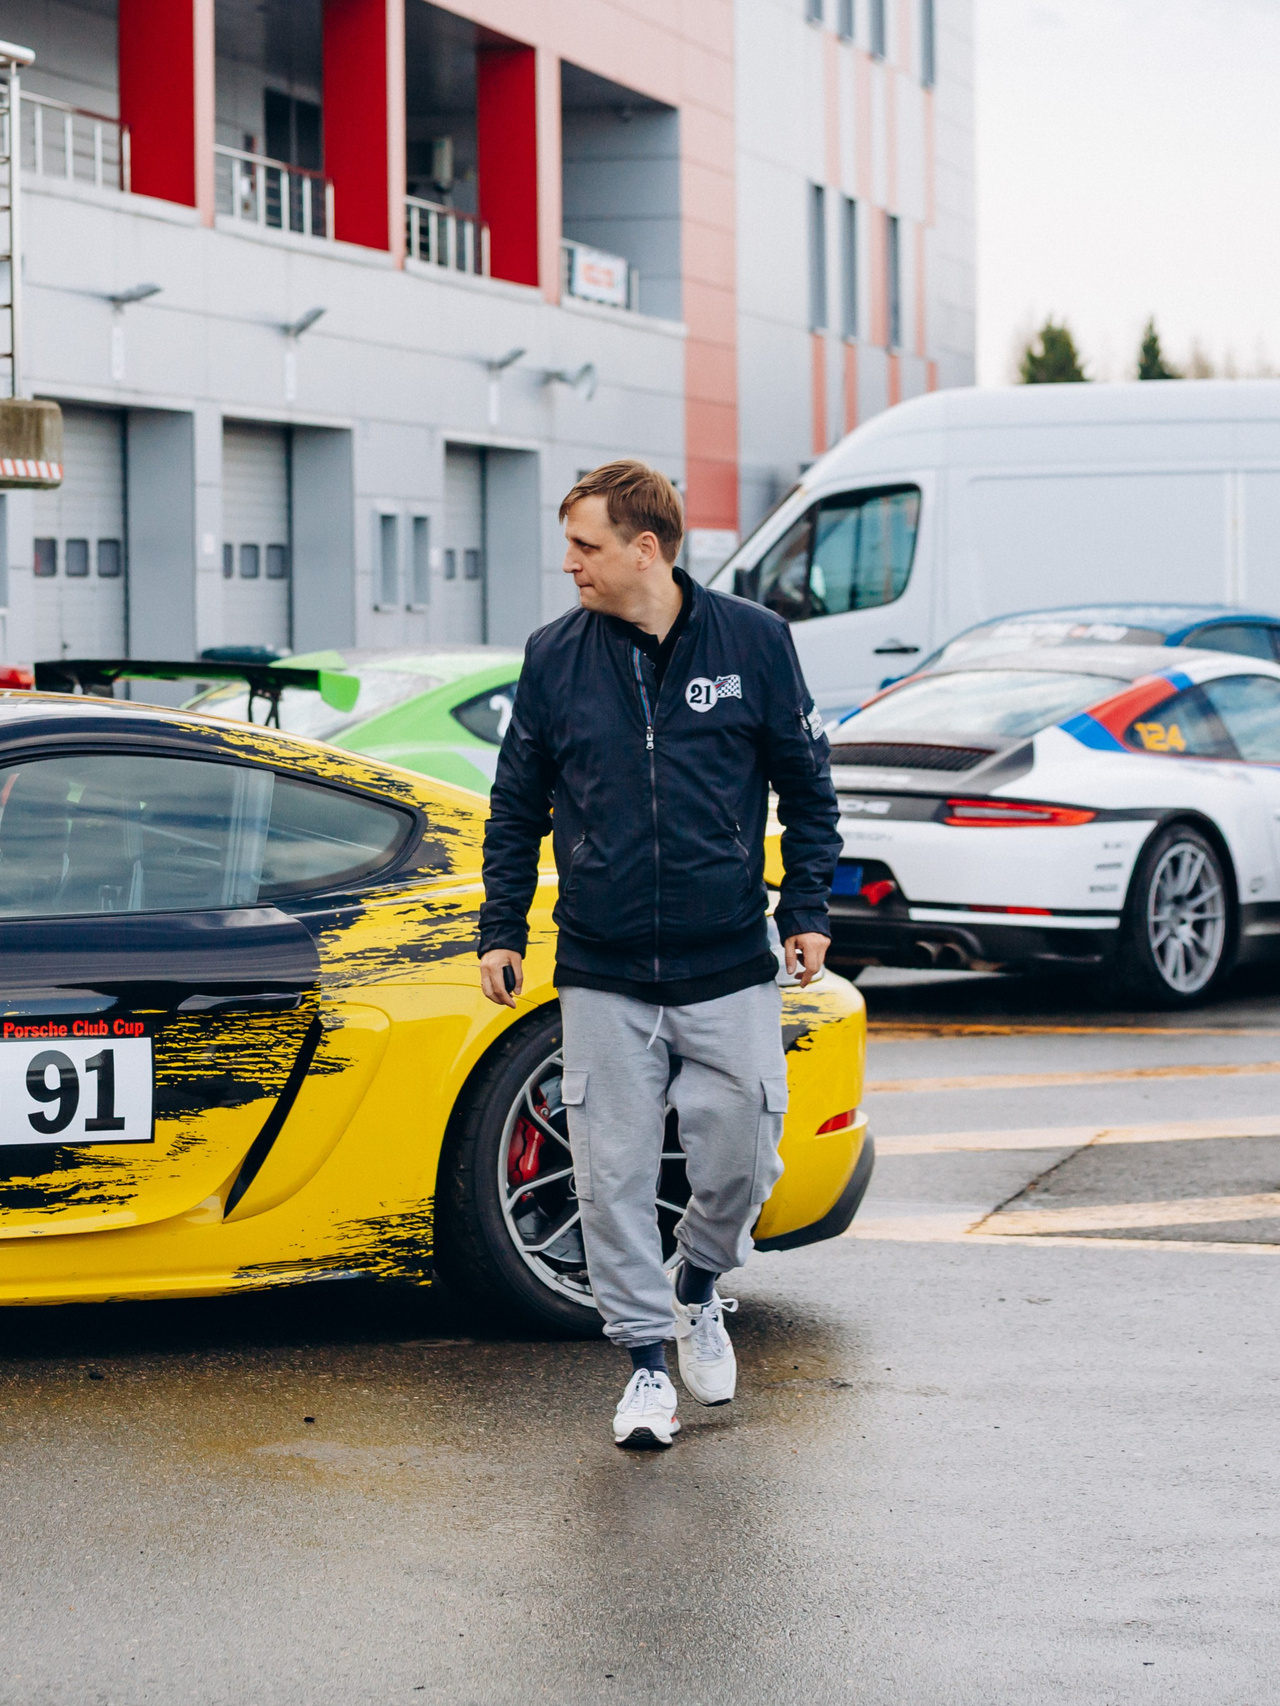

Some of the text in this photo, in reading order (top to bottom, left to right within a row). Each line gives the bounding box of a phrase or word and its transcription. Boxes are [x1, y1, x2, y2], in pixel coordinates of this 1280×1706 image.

[690, 684, 712, 705] 21
[1134, 722, 1187, 752] 124
[3, 1018, 145, 1039] Porsche Club Cup
[26, 1049, 125, 1135] 91
